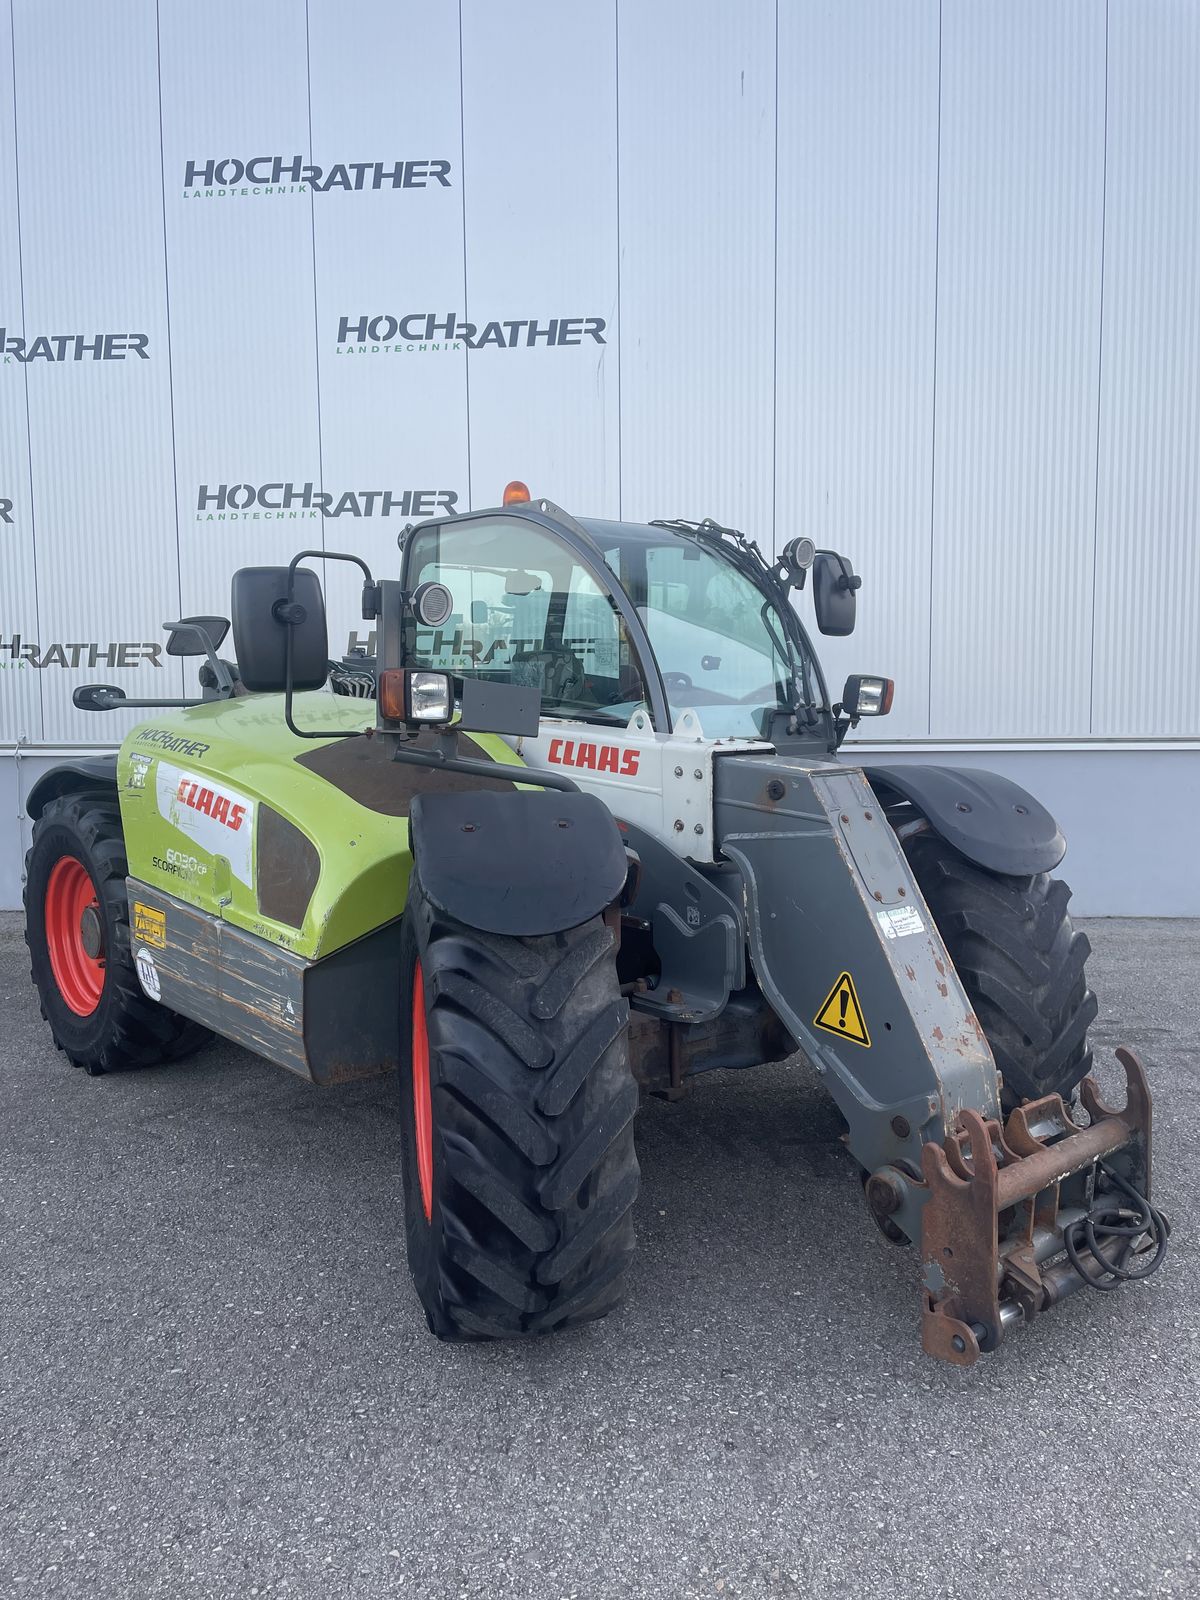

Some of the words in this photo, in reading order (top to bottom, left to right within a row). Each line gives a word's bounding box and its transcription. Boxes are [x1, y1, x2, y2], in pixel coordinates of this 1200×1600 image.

[184, 155, 453, 192] HOCHRATHER
[183, 185, 307, 199] LANDTECHNIK
[336, 342, 461, 354] LANDTECHNIK
[337, 313, 608, 349] HOCHRATHER
[196, 511, 317, 521] LANDTECHNIK
[197, 482, 458, 518] HOCHRATHER
[136, 728, 210, 758] HOCHRATHER
[548, 739, 641, 776] CLAAS
[177, 778, 247, 831] CLAAS
